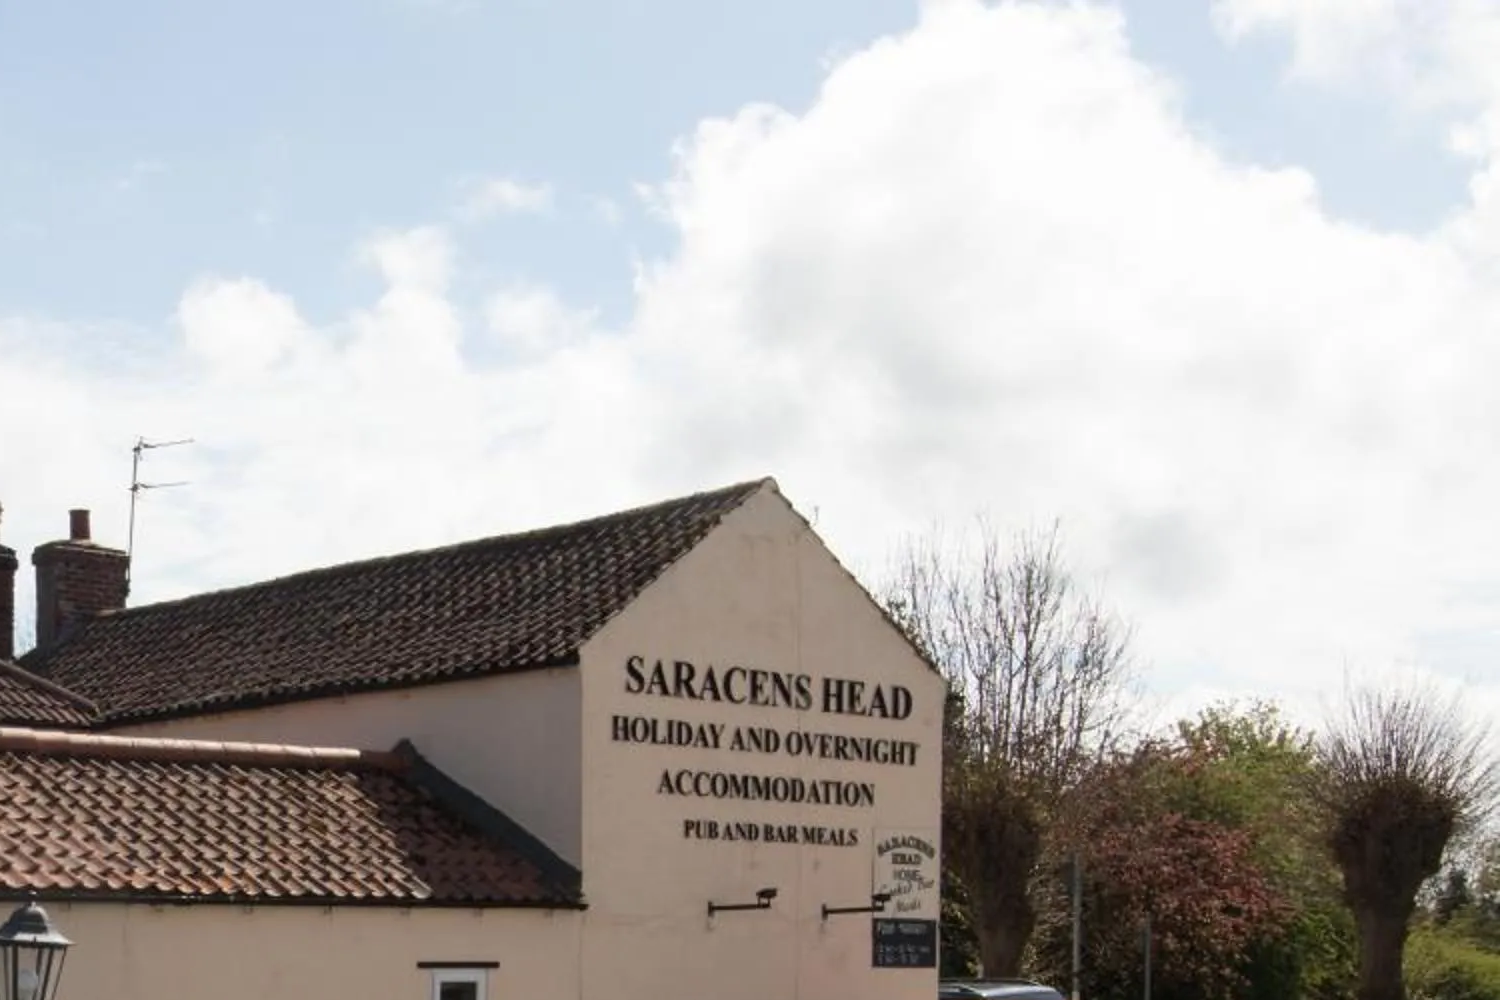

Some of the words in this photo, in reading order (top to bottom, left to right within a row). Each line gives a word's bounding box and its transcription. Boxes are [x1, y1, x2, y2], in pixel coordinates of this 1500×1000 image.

[625, 655, 812, 711] SARACENS
[821, 677, 913, 720] HEAD
[611, 715, 725, 748] HOLIDAY
[730, 727, 780, 753] AND
[785, 732, 920, 766] OVERNIGHT
[657, 769, 875, 807] ACCOMMODATION
[683, 819, 719, 840] PUB
[721, 822, 759, 841] AND
[763, 824, 799, 844] BAR
[801, 826, 858, 847] MEALS
